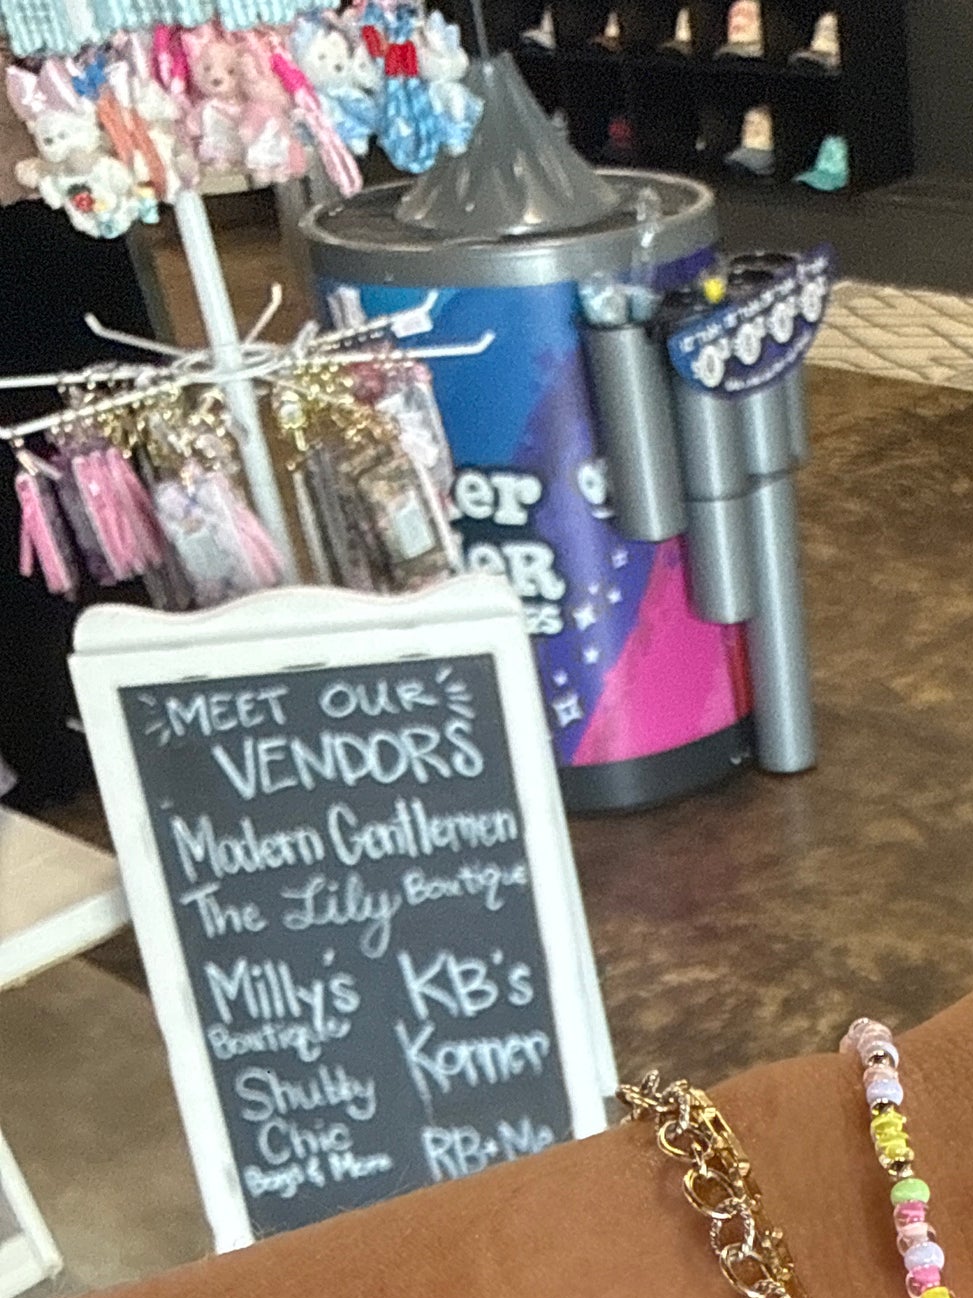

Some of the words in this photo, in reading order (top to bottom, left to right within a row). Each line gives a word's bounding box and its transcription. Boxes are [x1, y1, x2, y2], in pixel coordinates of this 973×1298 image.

[166, 684, 289, 736] MEET
[320, 679, 438, 718] OUR
[211, 719, 485, 800] VENDORS
[170, 814, 325, 883] Modern
[327, 798, 519, 866] Gentlemen
[179, 881, 269, 938] The
[281, 870, 402, 959] Lily
[203, 948, 361, 1034] Milly's
[397, 949, 534, 1021] KB's
[257, 1117, 354, 1165] Chic
